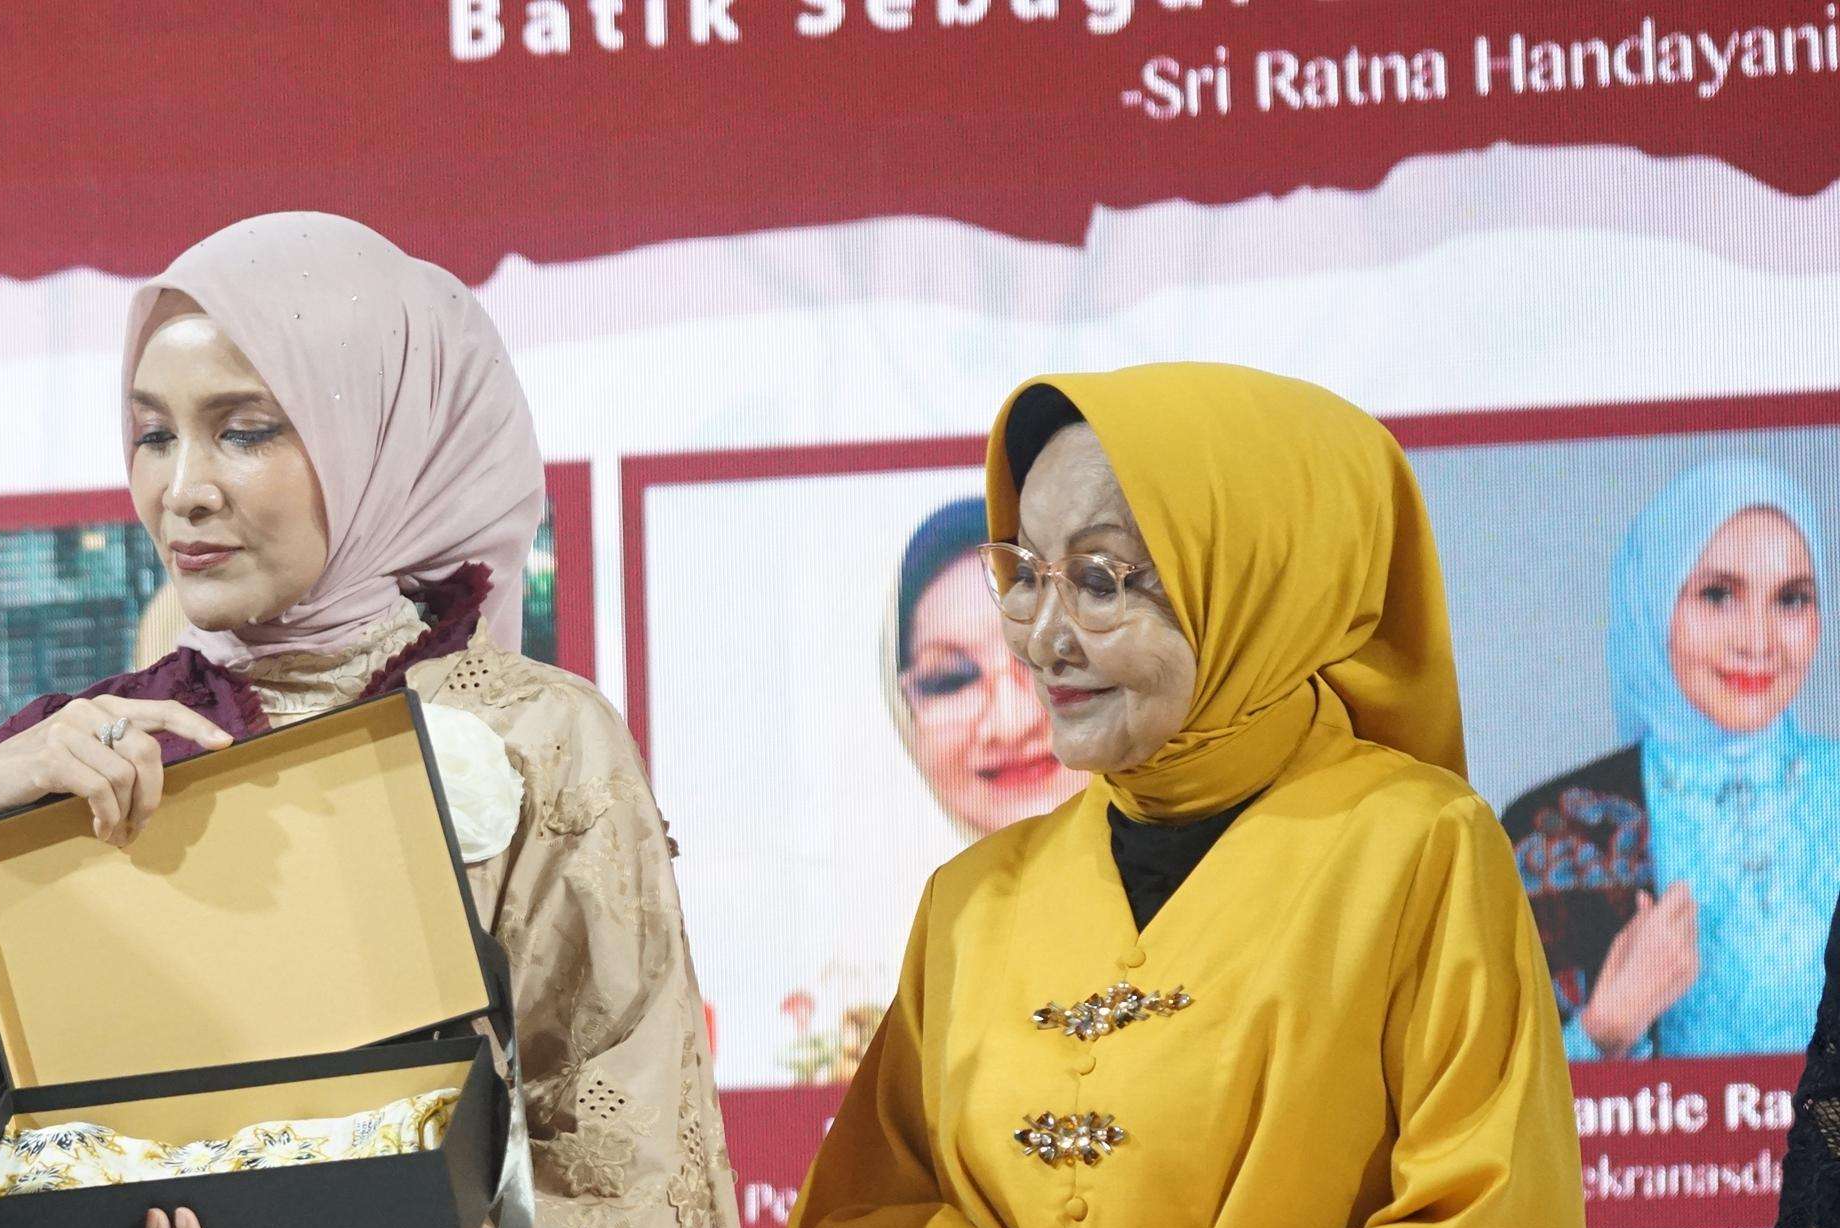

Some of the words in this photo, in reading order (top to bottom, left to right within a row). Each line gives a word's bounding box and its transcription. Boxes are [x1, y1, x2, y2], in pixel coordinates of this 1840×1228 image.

[449, 0, 742, 61] Batik
[1256, 45, 1447, 112] Ratna
[1474, 2, 1840, 98] Handayani
